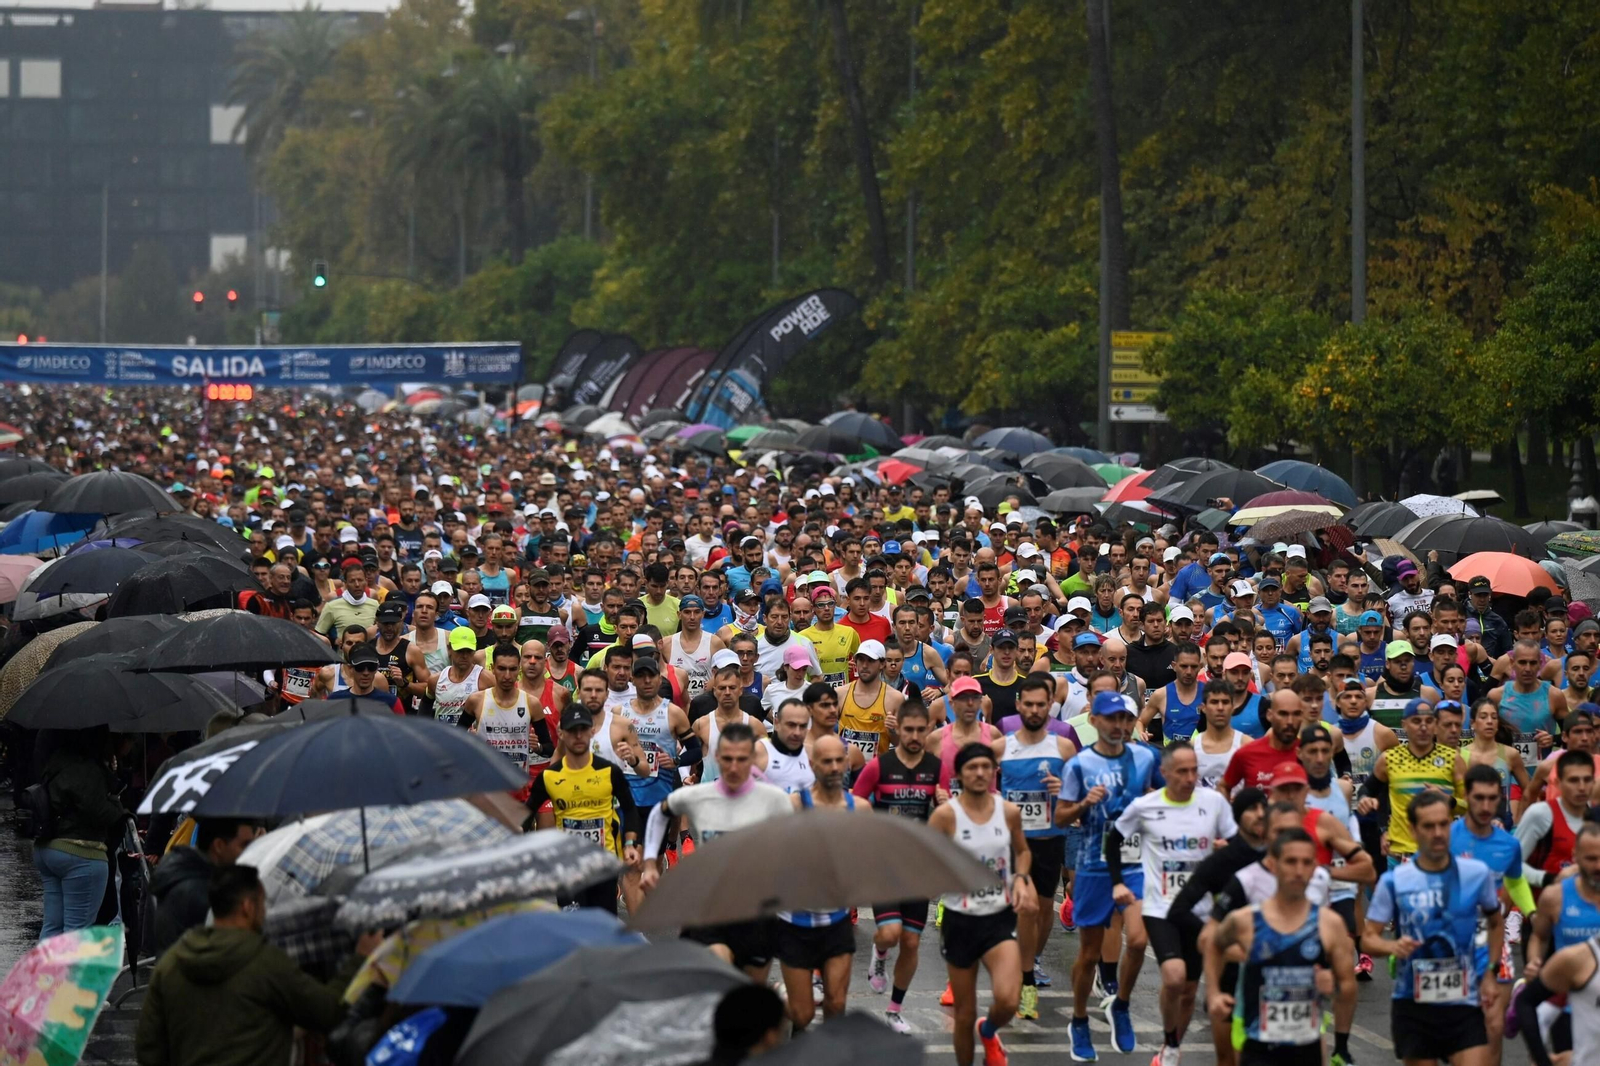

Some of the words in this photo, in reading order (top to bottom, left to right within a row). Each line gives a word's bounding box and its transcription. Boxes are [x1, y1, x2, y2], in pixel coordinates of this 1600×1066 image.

[769, 294, 825, 342] POWER
[799, 307, 831, 335] ADE
[34, 355, 91, 370] IMDECO
[171, 355, 266, 377] SALIDA
[366, 354, 426, 369] IMDECO
[287, 675, 311, 688] 7732
[893, 787, 927, 800] LUCAS
[1421, 974, 1462, 991] 2148
[1268, 1003, 1311, 1022] 2164
